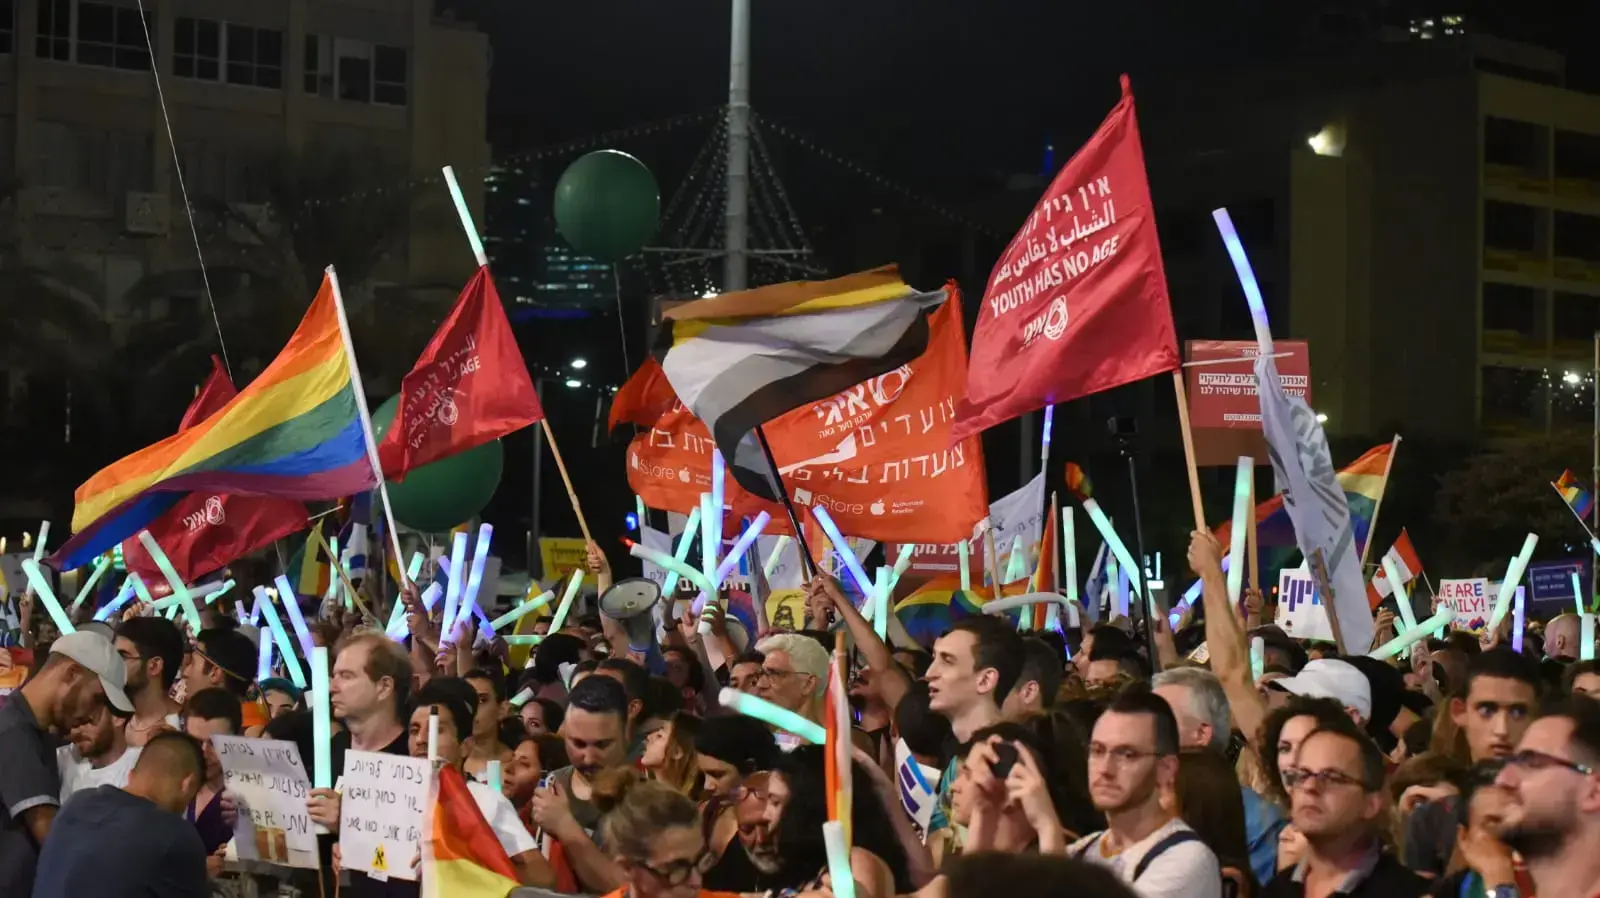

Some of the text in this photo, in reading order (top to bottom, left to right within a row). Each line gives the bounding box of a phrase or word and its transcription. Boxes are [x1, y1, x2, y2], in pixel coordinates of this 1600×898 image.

[1079, 176, 1112, 211] אין
[990, 235, 1120, 318] YOUTH HAS NO AGE
[461, 356, 481, 376] AGE
[812, 493, 864, 515] iStore
[1440, 583, 1483, 599] WE ARE
[1441, 597, 1485, 613] AMILY!
